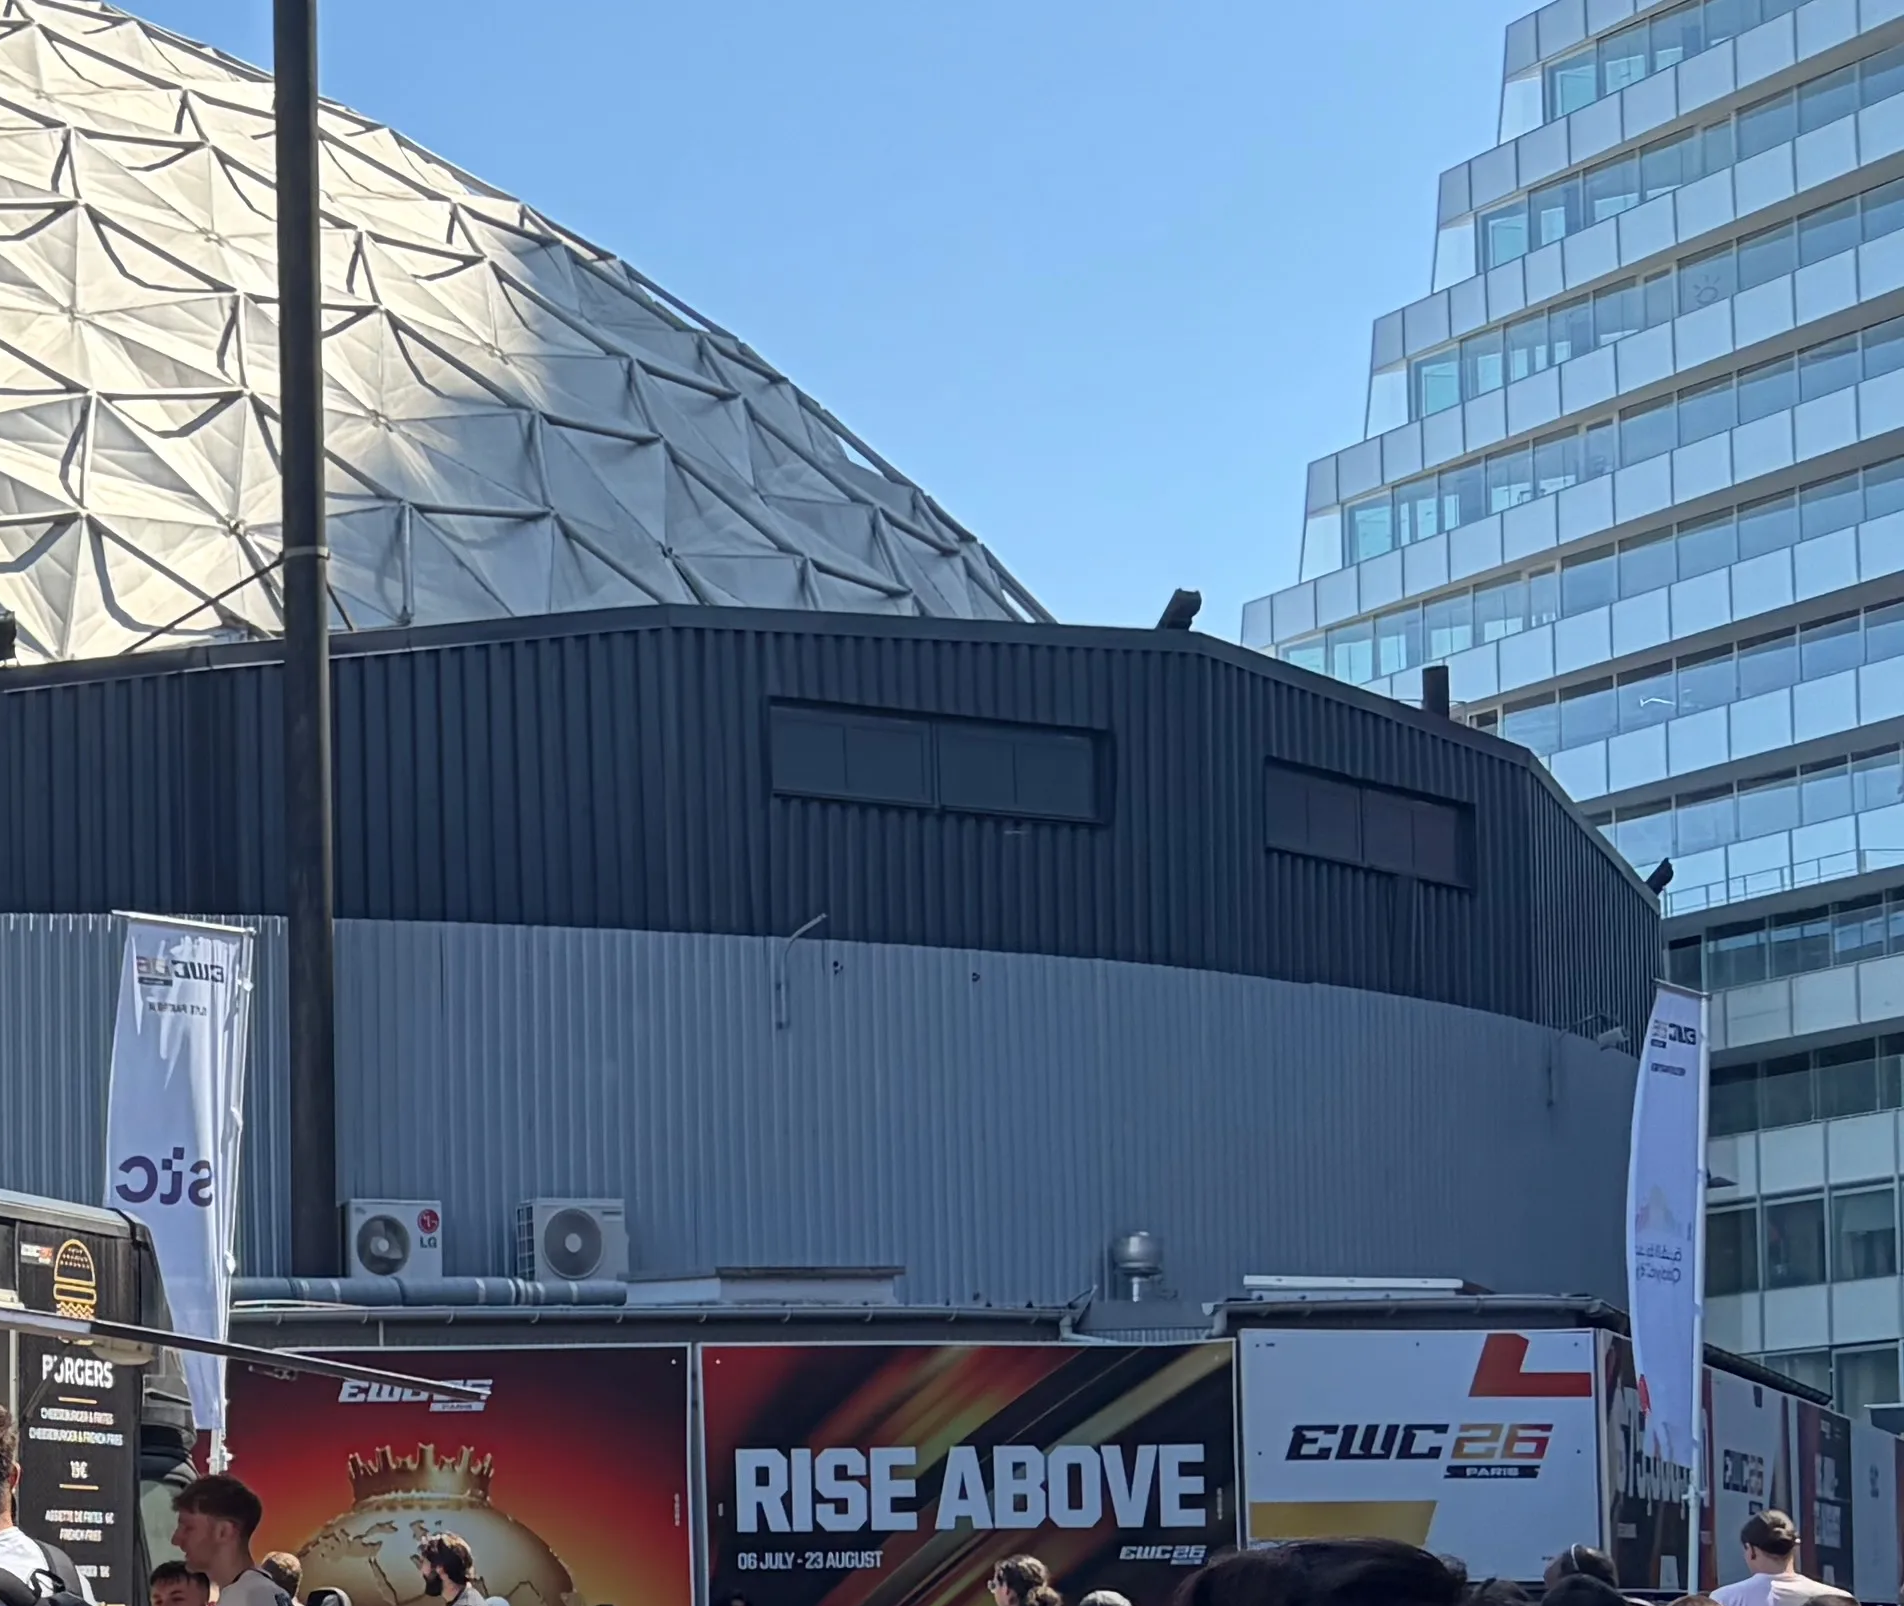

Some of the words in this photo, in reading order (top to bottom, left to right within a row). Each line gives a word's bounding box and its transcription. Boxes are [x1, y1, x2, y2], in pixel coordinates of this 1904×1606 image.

[419, 1236, 437, 1249] LG
[734, 1446, 918, 1533] RISE
[935, 1443, 1206, 1529] ABOVE
[737, 1552, 758, 1570] 06
[758, 1551, 795, 1570] JULY
[804, 1551, 824, 1569] 23
[824, 1550, 883, 1569] AUGUST
